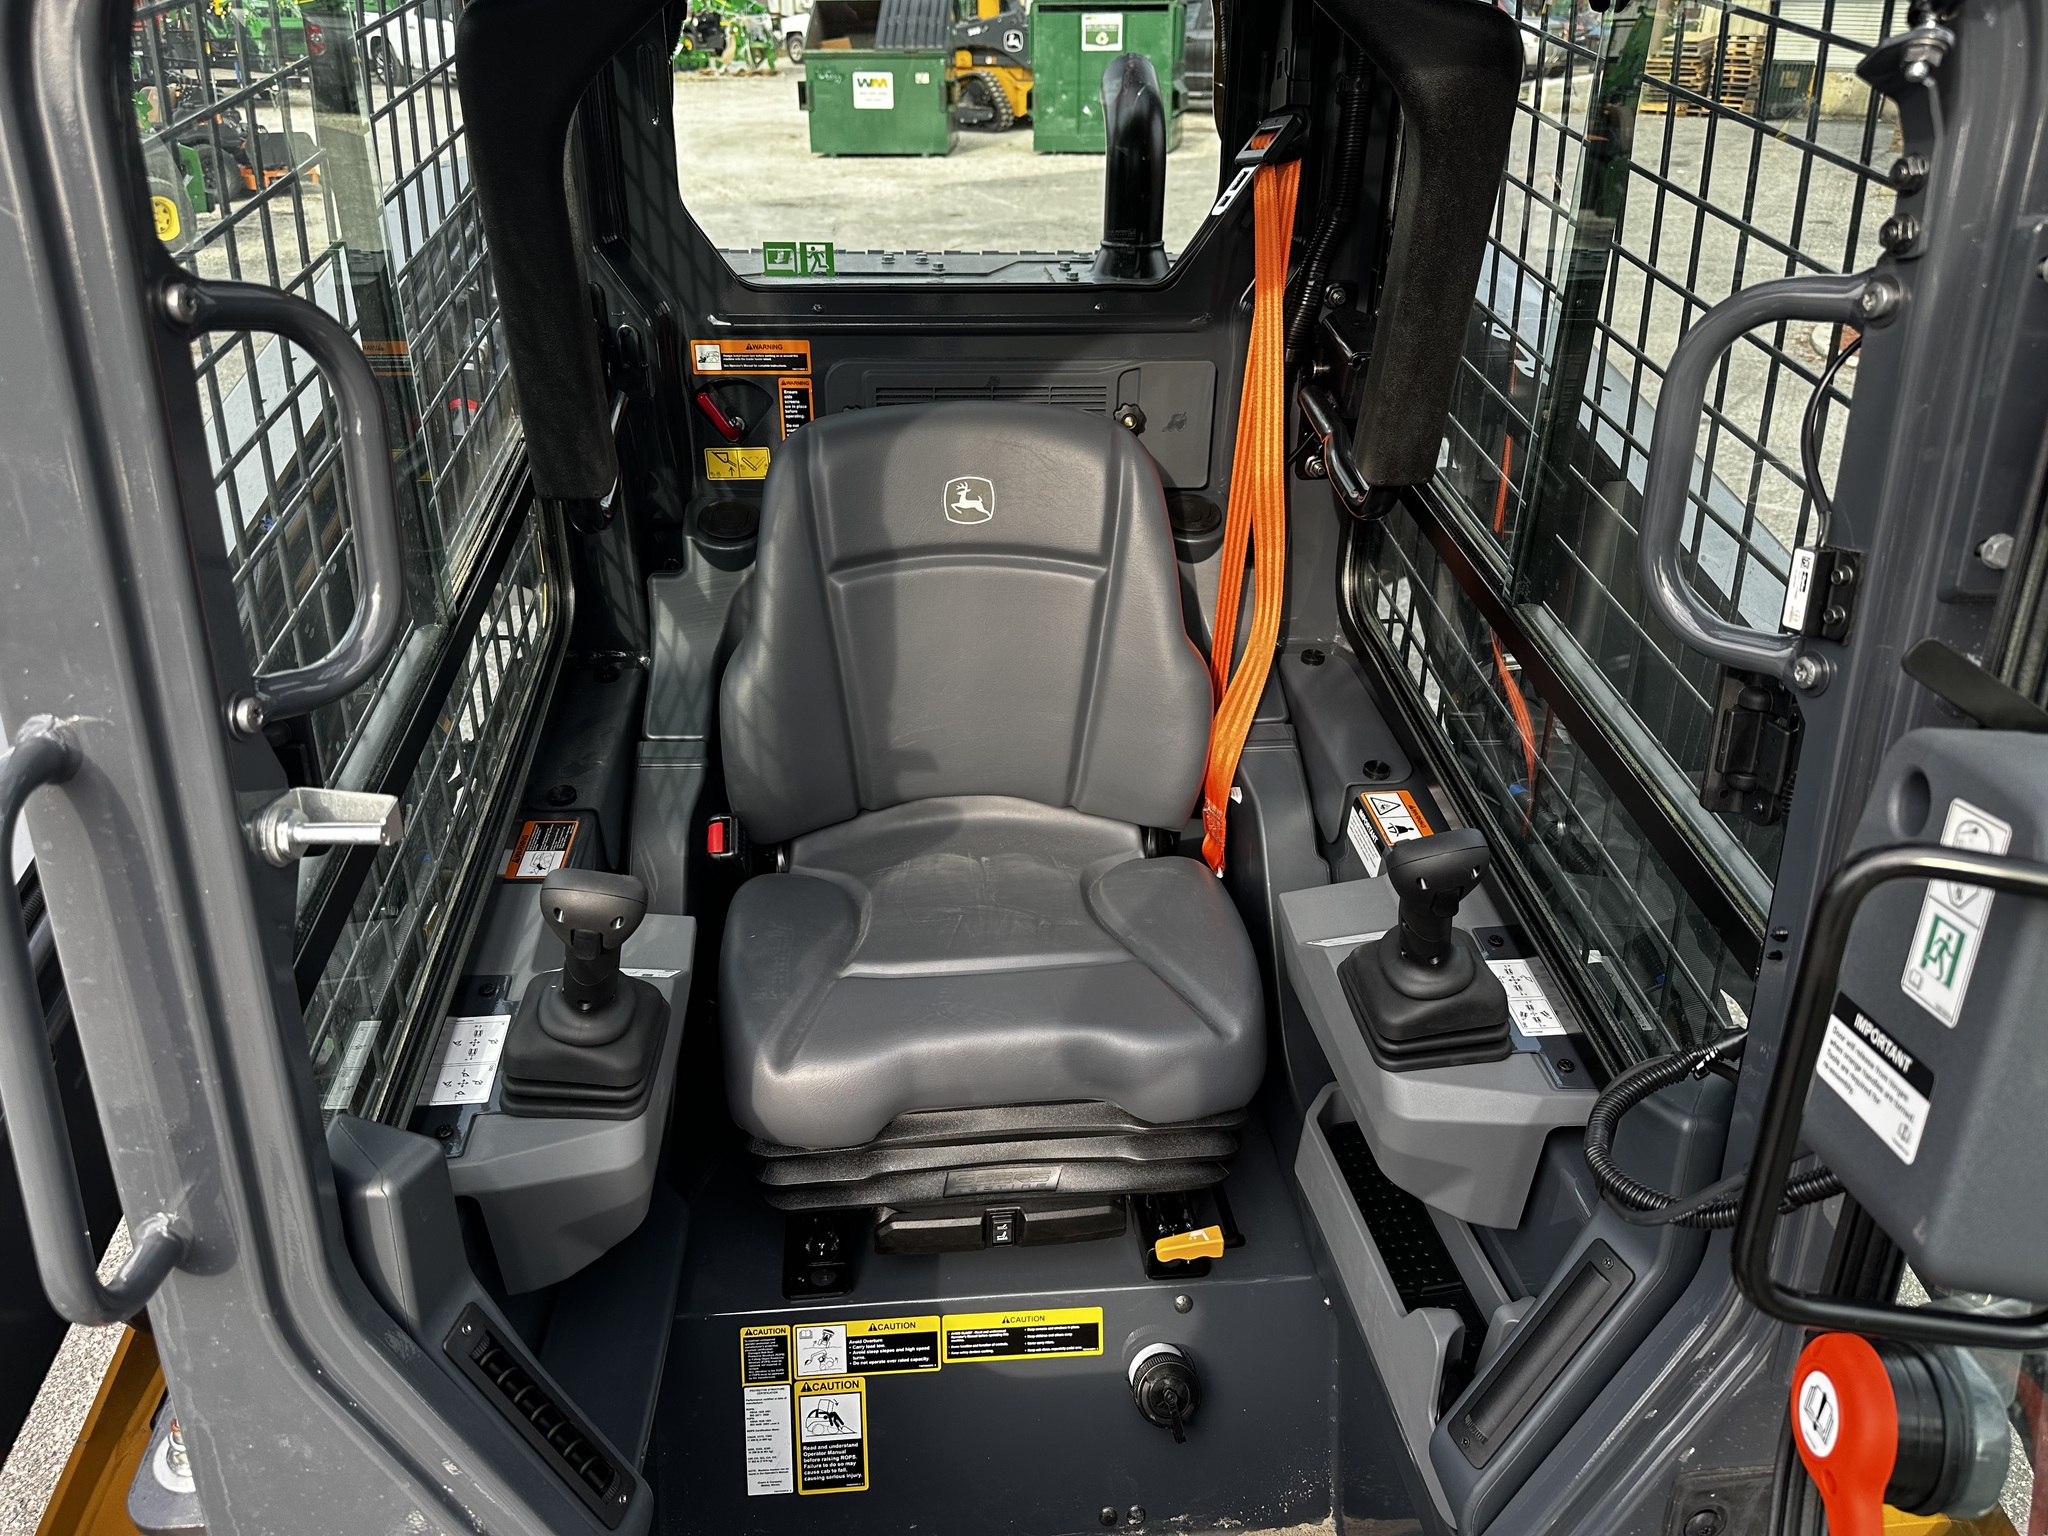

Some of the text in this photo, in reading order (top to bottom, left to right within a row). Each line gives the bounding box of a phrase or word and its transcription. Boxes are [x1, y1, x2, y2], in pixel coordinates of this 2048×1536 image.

[1358, 808, 1378, 843] IMPORTANT
[1854, 1012, 1913, 1073] IMPORTANT
[878, 1322, 916, 1330] CAUTION
[812, 1380, 859, 1391] CAUTION
